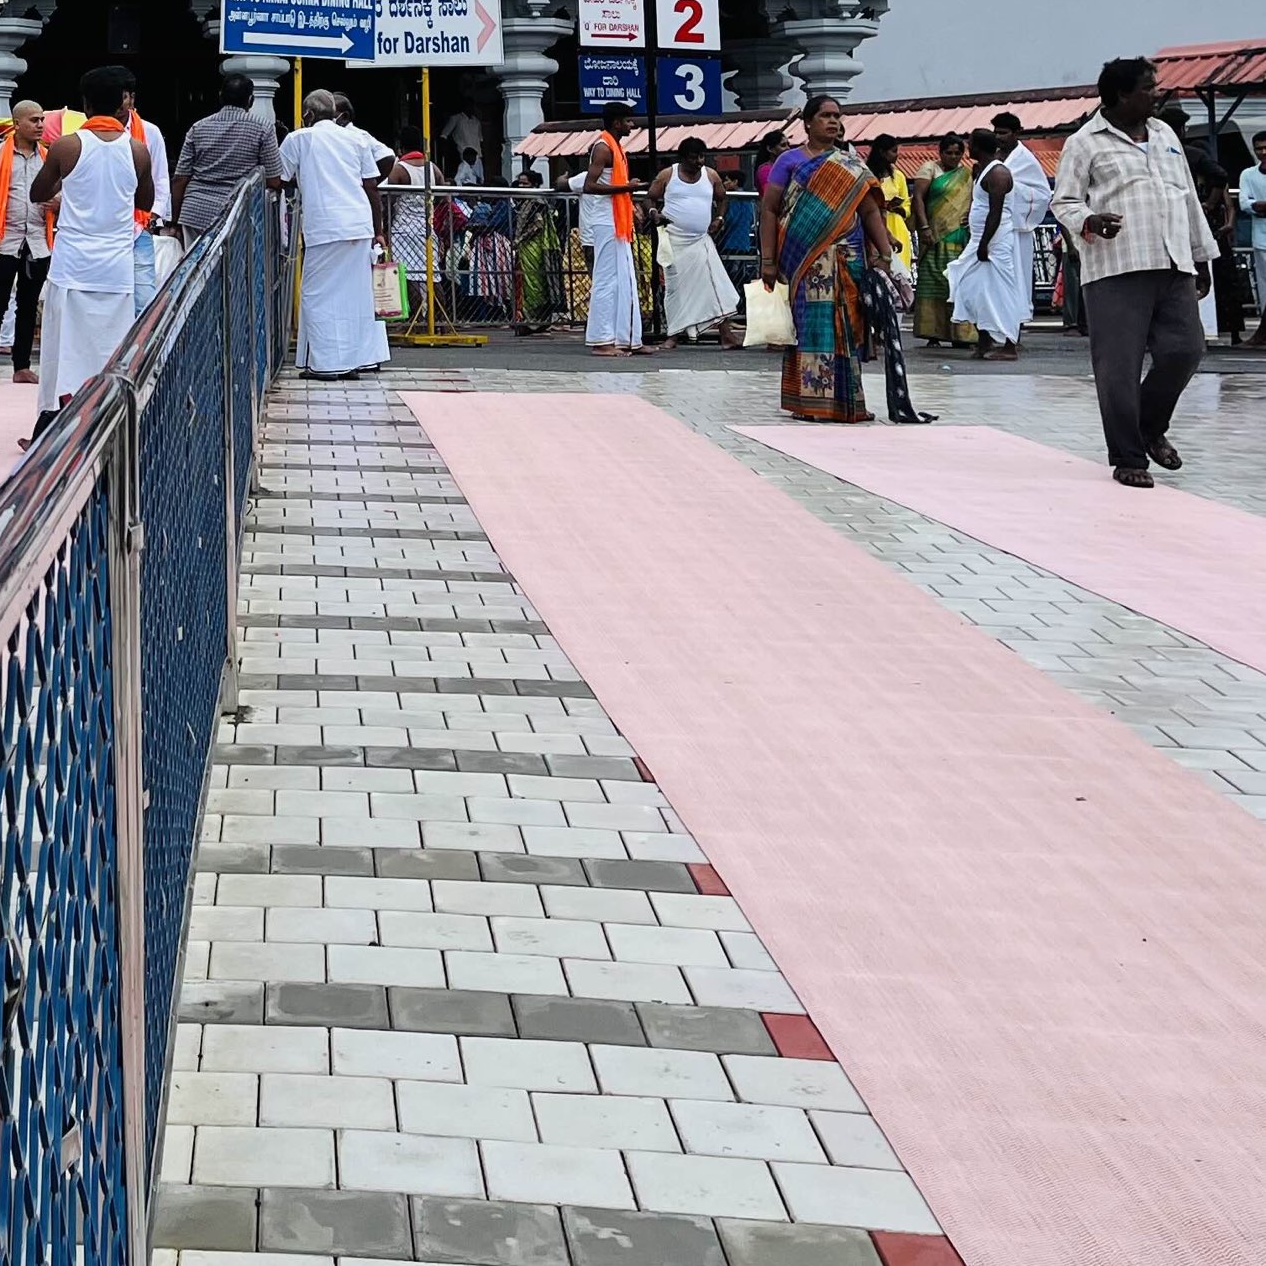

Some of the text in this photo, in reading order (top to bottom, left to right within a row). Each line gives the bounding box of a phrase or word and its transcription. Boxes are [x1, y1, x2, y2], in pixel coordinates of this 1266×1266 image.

[594, 22, 607, 31] FOR
[609, 23, 639, 32] DARSHAN
[377, 31, 470, 54] for Darshan
[583, 87, 642, 98] WAY TO DINING HALL
[673, 63, 706, 111] 3
